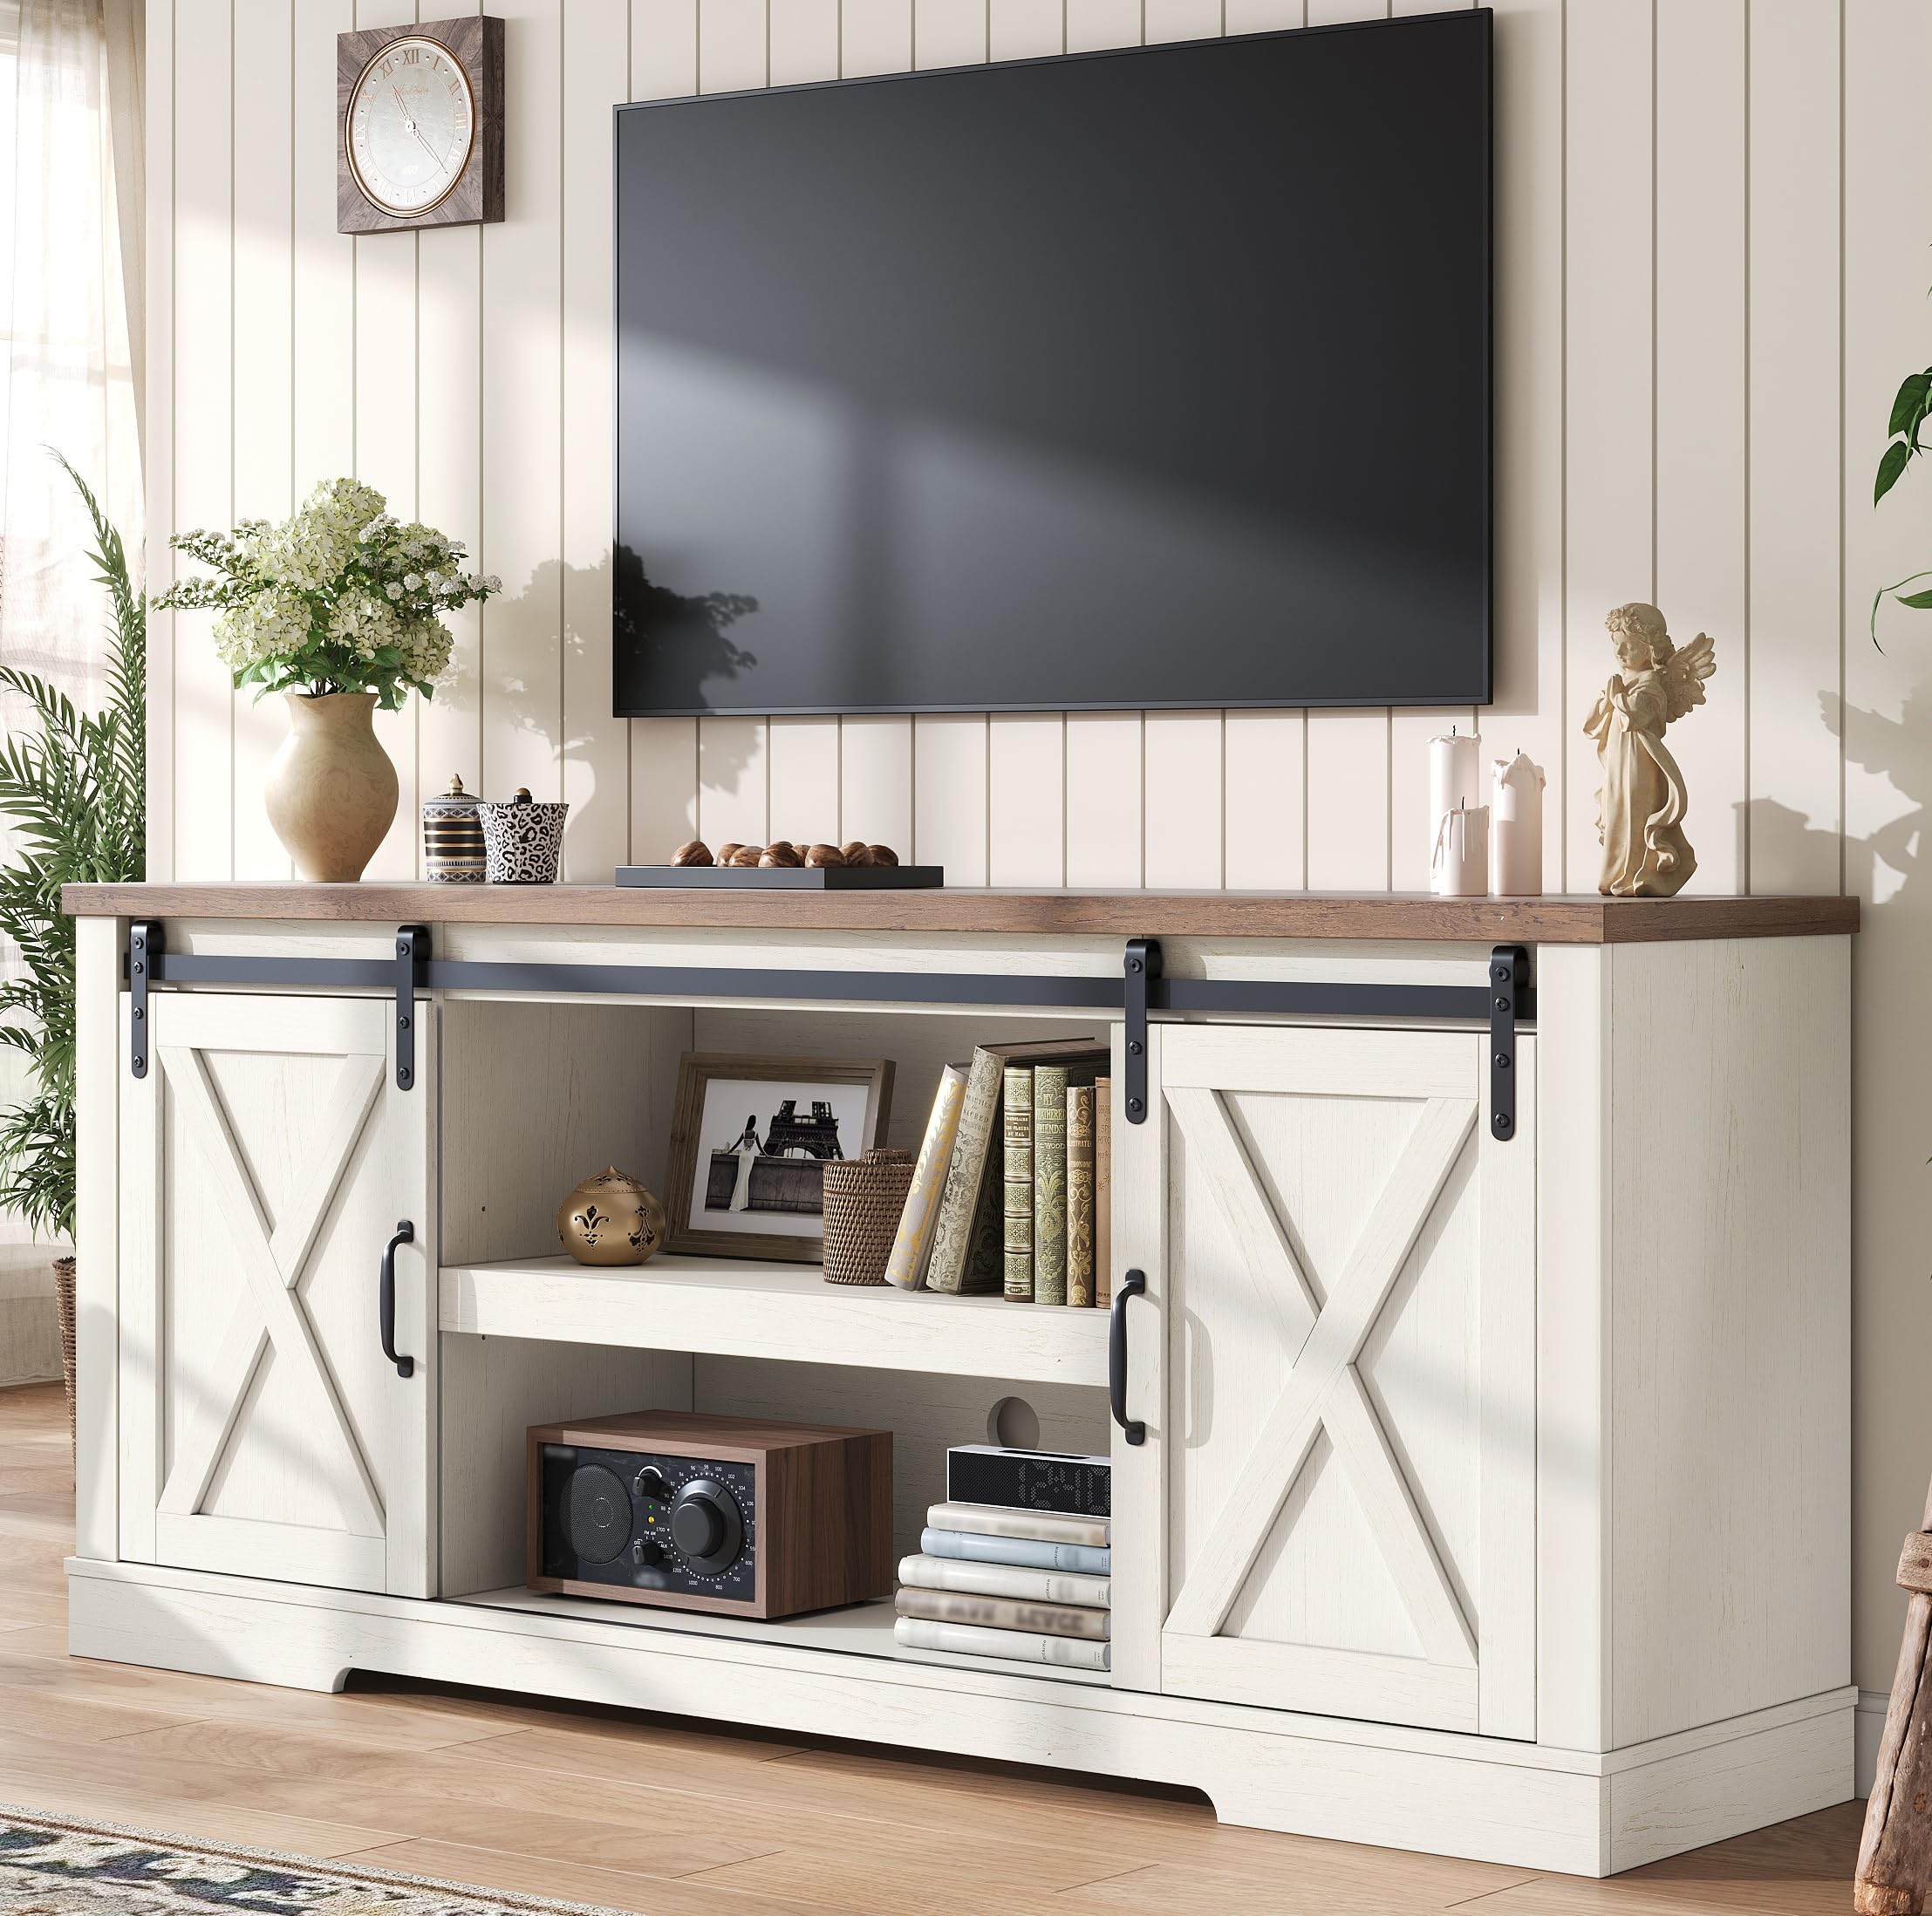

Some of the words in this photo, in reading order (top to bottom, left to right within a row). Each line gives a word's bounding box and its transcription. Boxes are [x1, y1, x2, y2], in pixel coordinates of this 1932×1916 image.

[403, 48, 420, 65] XII
[378, 58, 394, 79] XI
[455, 112, 468, 130] III
[355, 124, 366, 140] IX
[1019, 1461, 1109, 1514] 12:40
